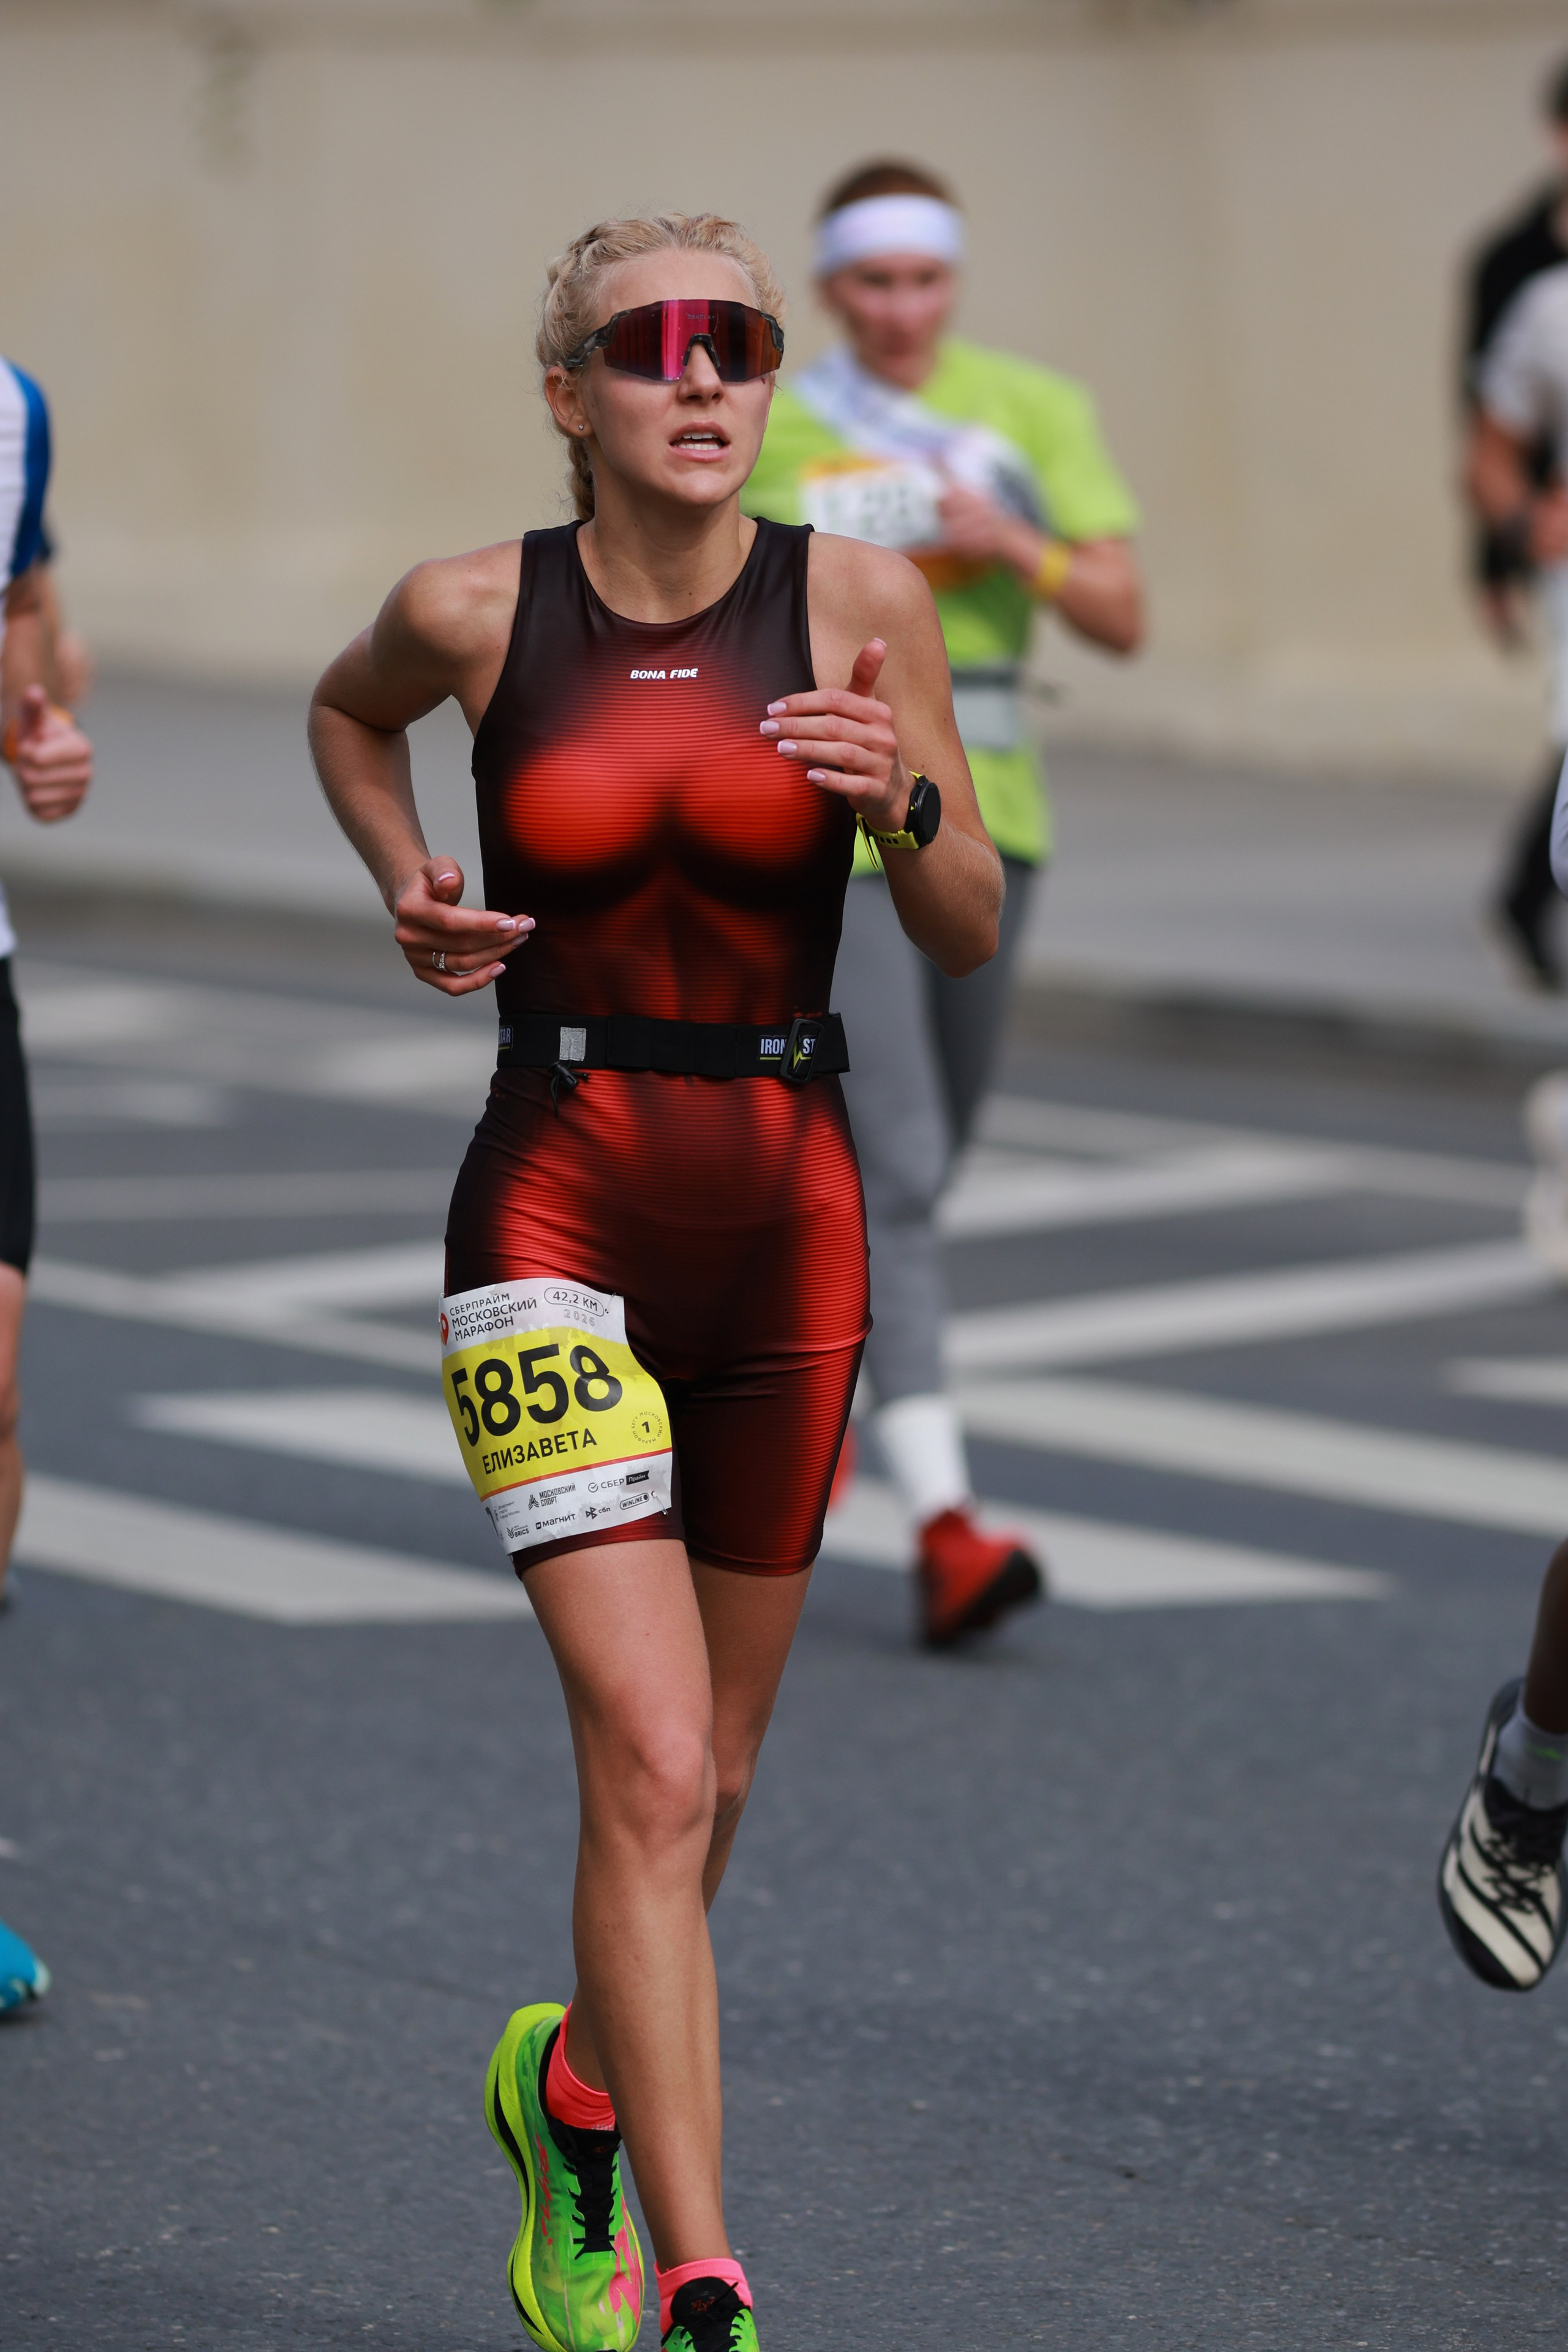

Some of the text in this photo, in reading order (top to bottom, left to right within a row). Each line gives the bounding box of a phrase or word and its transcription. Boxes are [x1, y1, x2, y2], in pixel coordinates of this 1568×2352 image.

[630, 668, 698, 679] BONA FIDE
[802, 1038, 816, 1054] ST
[450, 1293, 510, 1316] СБЕРПРАЙМ
[553, 1291, 597, 1311] 42,2 КМ
[452, 1297, 537, 1329] МОСКОВСКИЙ
[564, 1309, 595, 1327] 2026
[454, 1316, 514, 1341] МАРАФОН
[451, 1344, 623, 1447] 5858
[641, 1421, 650, 1433] 1
[482, 1428, 597, 1475] ЕЛИЗАВЕТА
[600, 1474, 646, 1488] СБЕР Прайм
[539, 1482, 576, 1499] МОСКОВСКИЙ
[540, 1496, 557, 1507] СПОРТ
[622, 1496, 643, 1508] WINLINE
[514, 1528, 529, 1537] BRICS
